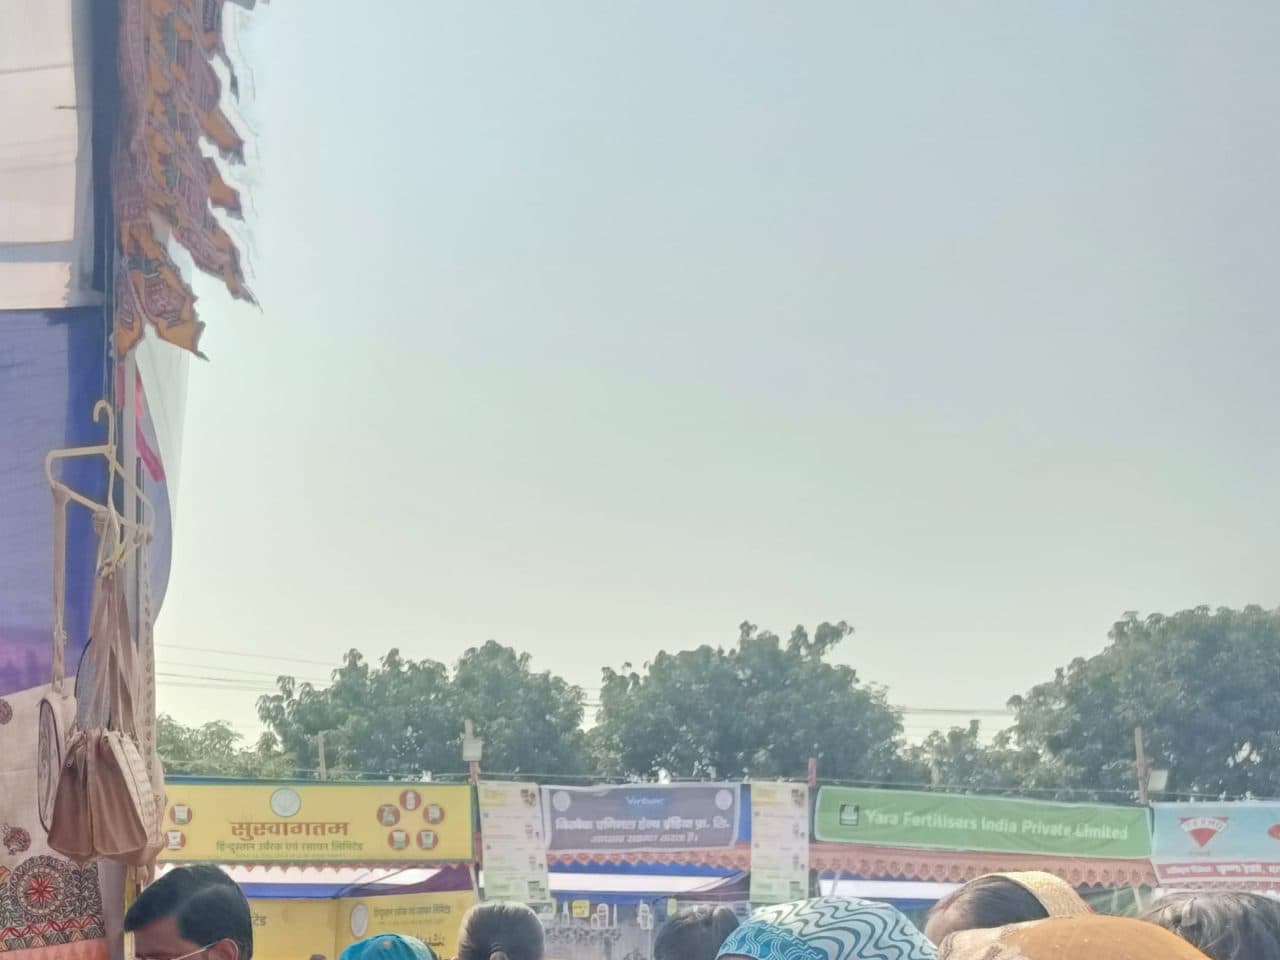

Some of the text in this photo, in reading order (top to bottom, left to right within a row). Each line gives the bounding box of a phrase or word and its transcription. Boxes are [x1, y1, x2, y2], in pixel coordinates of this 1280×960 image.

[230, 820, 350, 841] सुस्वागतम
[864, 809, 1128, 841] Yara Fertilisers India Private Limited
